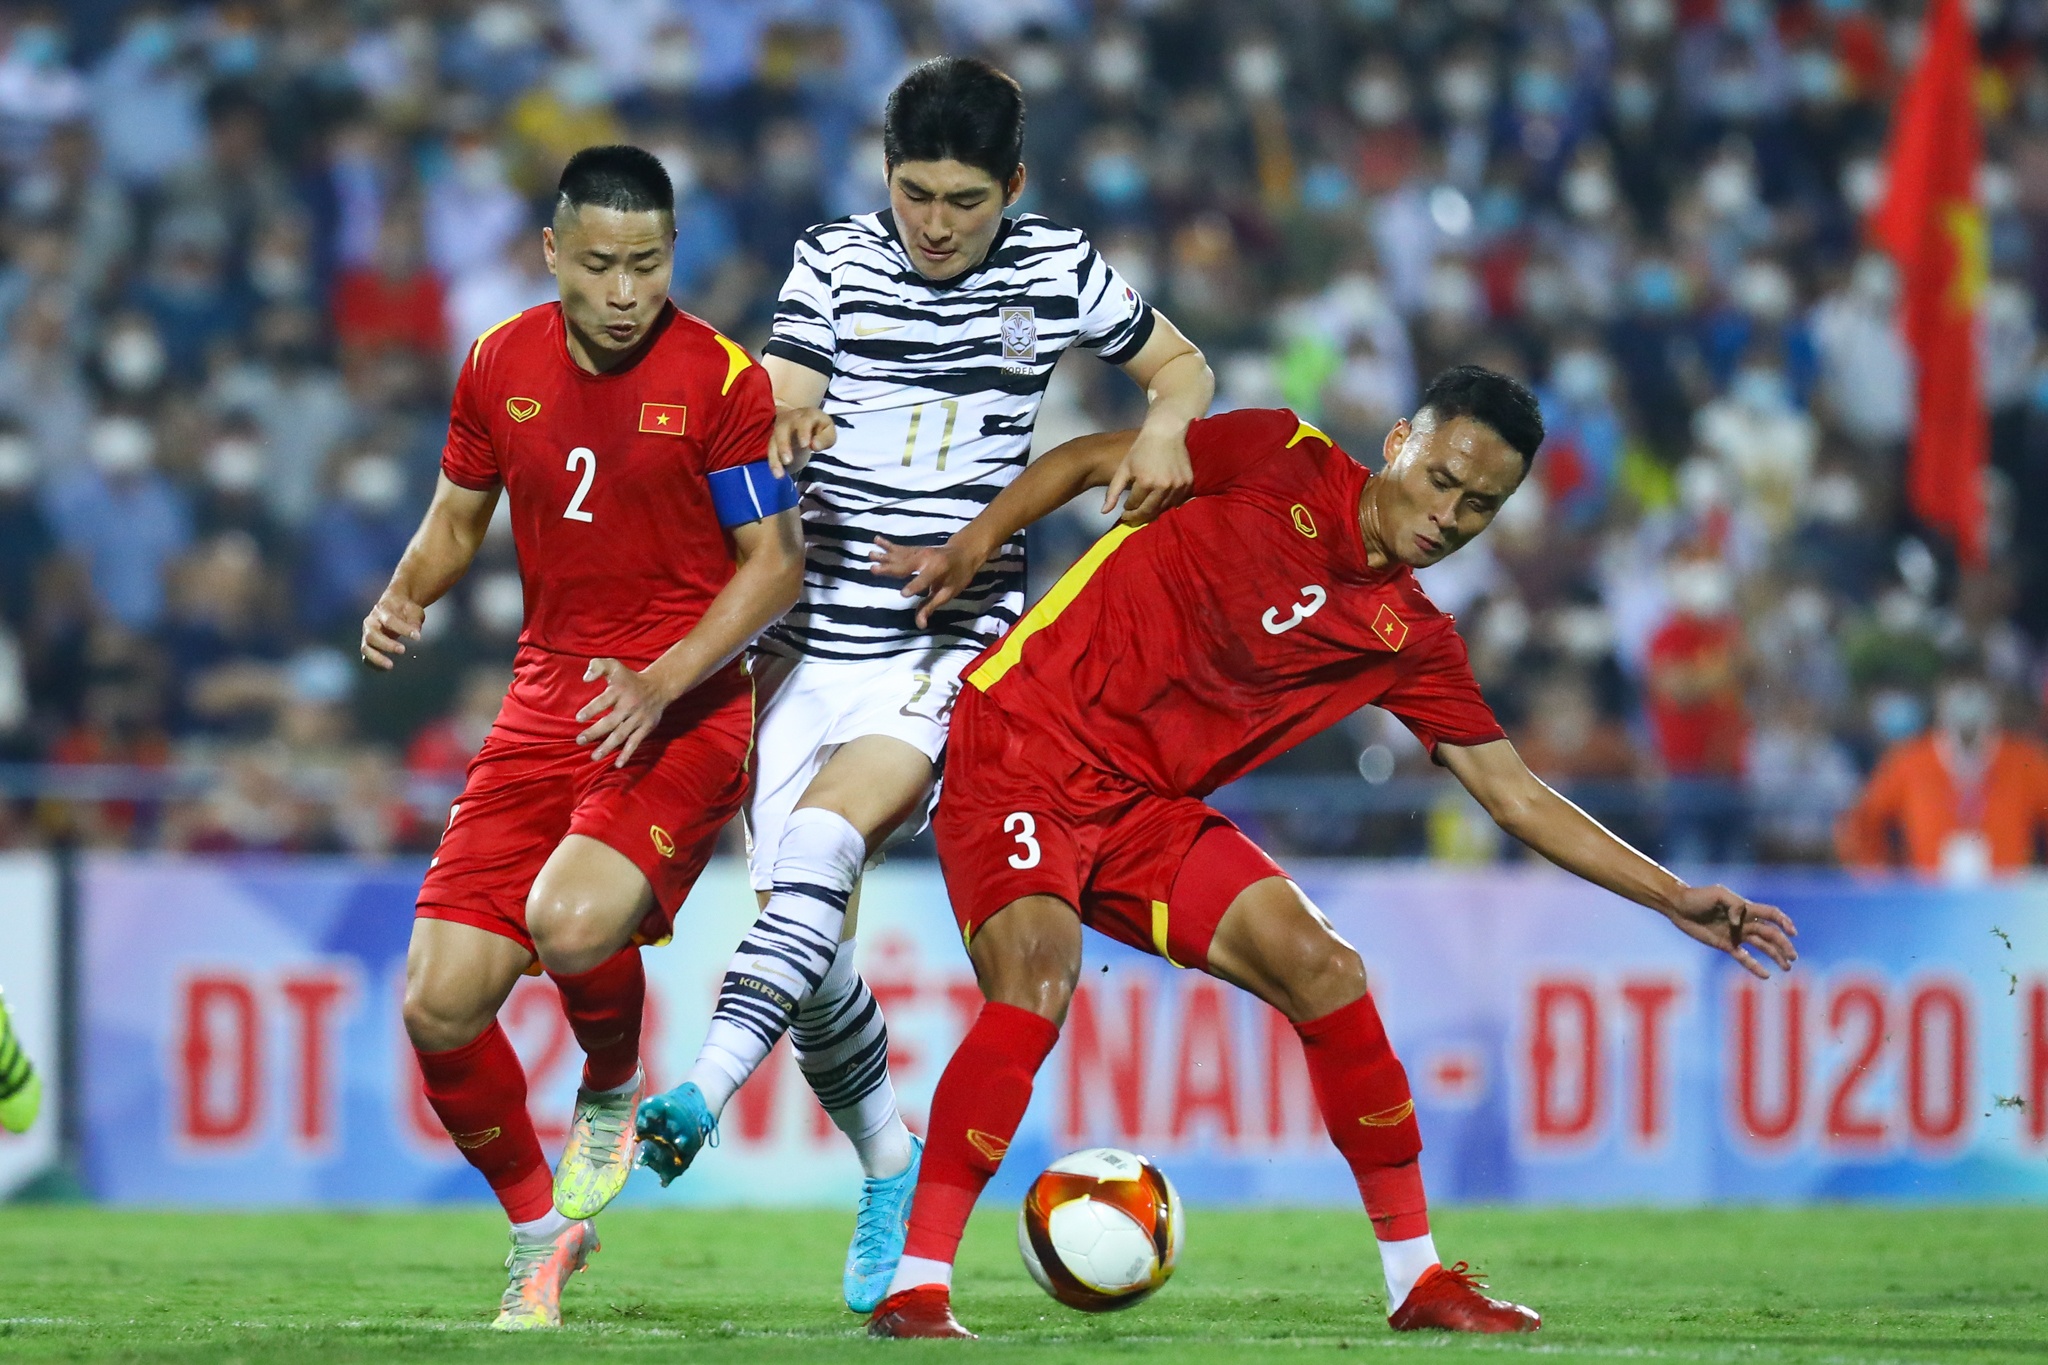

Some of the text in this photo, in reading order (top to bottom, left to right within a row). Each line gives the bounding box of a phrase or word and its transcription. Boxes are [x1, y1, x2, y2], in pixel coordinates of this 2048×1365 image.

[901, 399, 958, 472] 11
[562, 446, 597, 523] 2
[1261, 584, 1327, 635] 3
[1003, 811, 1041, 870] 3
[738, 976, 794, 1012] KOREA
[178, 970, 345, 1144] ĐT
[1529, 982, 1682, 1140] ĐT
[1736, 982, 1970, 1142] U20
